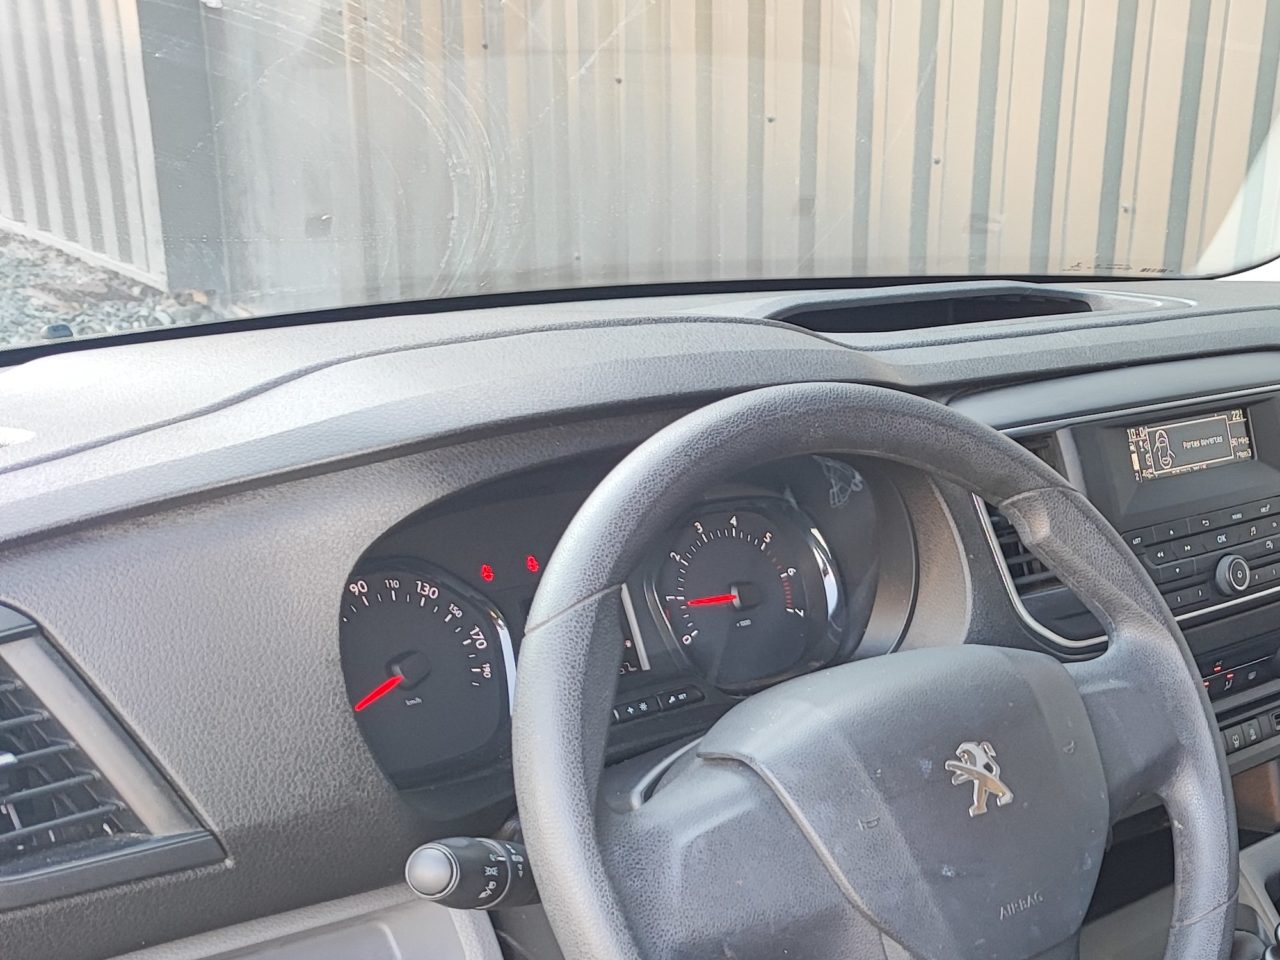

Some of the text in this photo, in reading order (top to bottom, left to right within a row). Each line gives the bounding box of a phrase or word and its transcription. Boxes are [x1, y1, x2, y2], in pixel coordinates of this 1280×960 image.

[729, 515, 738, 527] 4
[694, 521, 703, 534] 3
[763, 532, 773, 543] 5
[1217, 533, 1227, 544] OK
[669, 551, 681, 562] 2
[787, 567, 797, 577] 6
[349, 579, 368, 596] 90
[384, 579, 400, 589] 110
[415, 580, 439, 599] 130
[448, 603, 462, 618] 150
[794, 608, 804, 618] 7
[469, 625, 488, 649] 170
[682, 634, 692, 645] 0
[1000, 890, 1043, 920] AIRBAG
